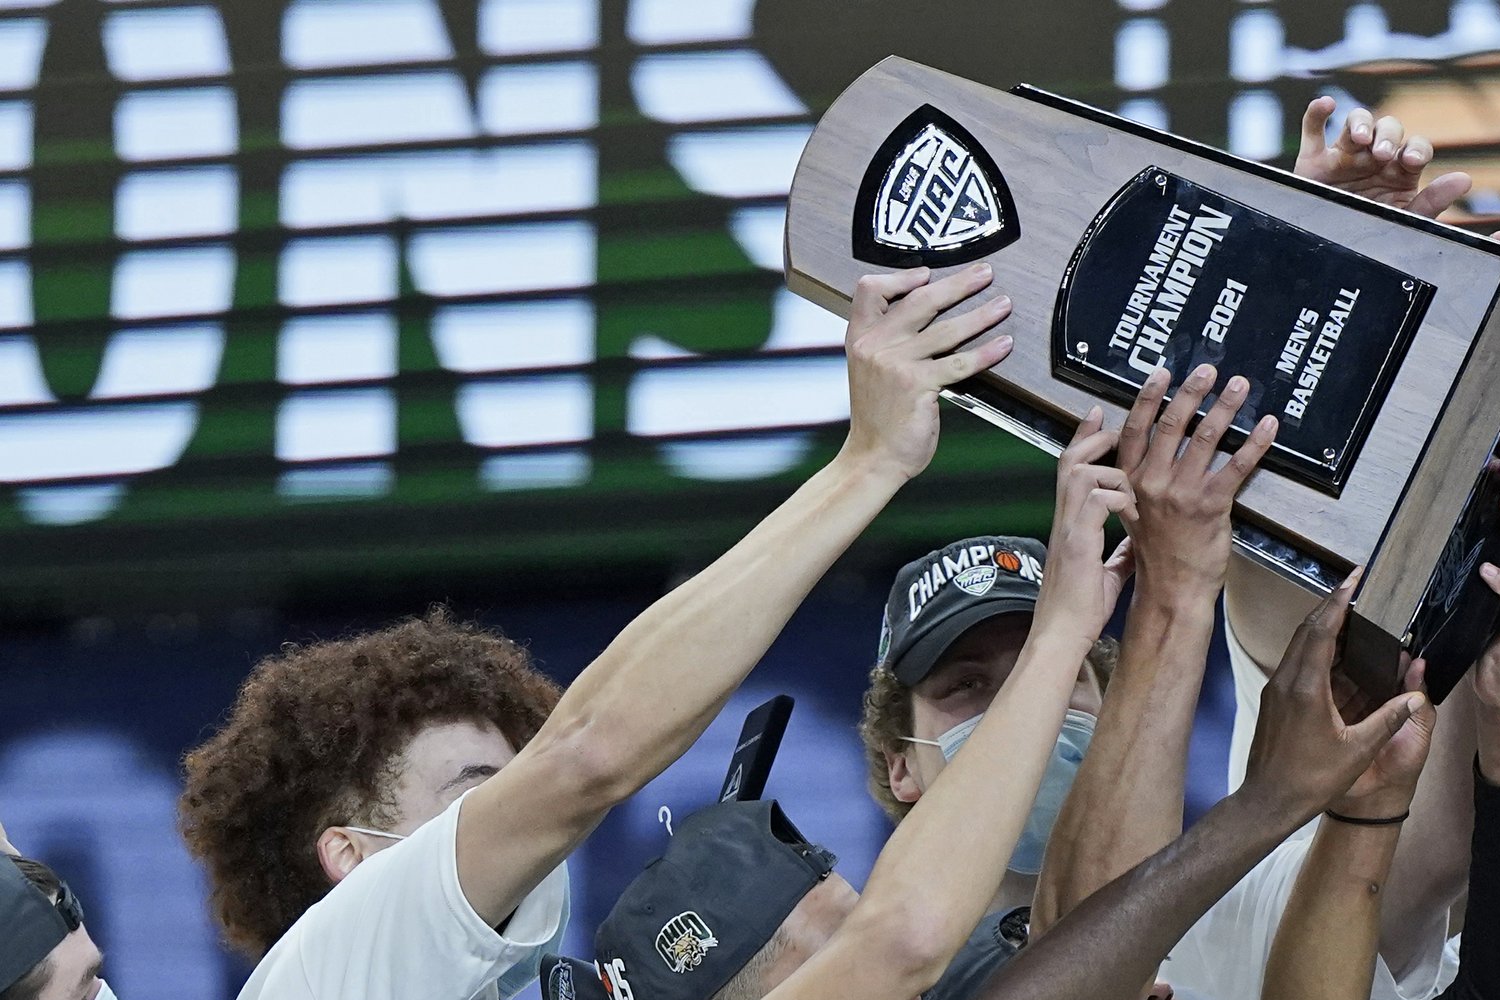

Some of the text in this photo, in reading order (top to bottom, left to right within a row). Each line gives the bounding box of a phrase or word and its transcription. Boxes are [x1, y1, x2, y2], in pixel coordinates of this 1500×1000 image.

[1109, 204, 1191, 350] TOURNAMENT
[1128, 203, 1233, 375] CHAMPION
[1202, 278, 1249, 343] 2021
[1275, 308, 1320, 375] MEN'S
[1284, 288, 1361, 419] BASKETBALL
